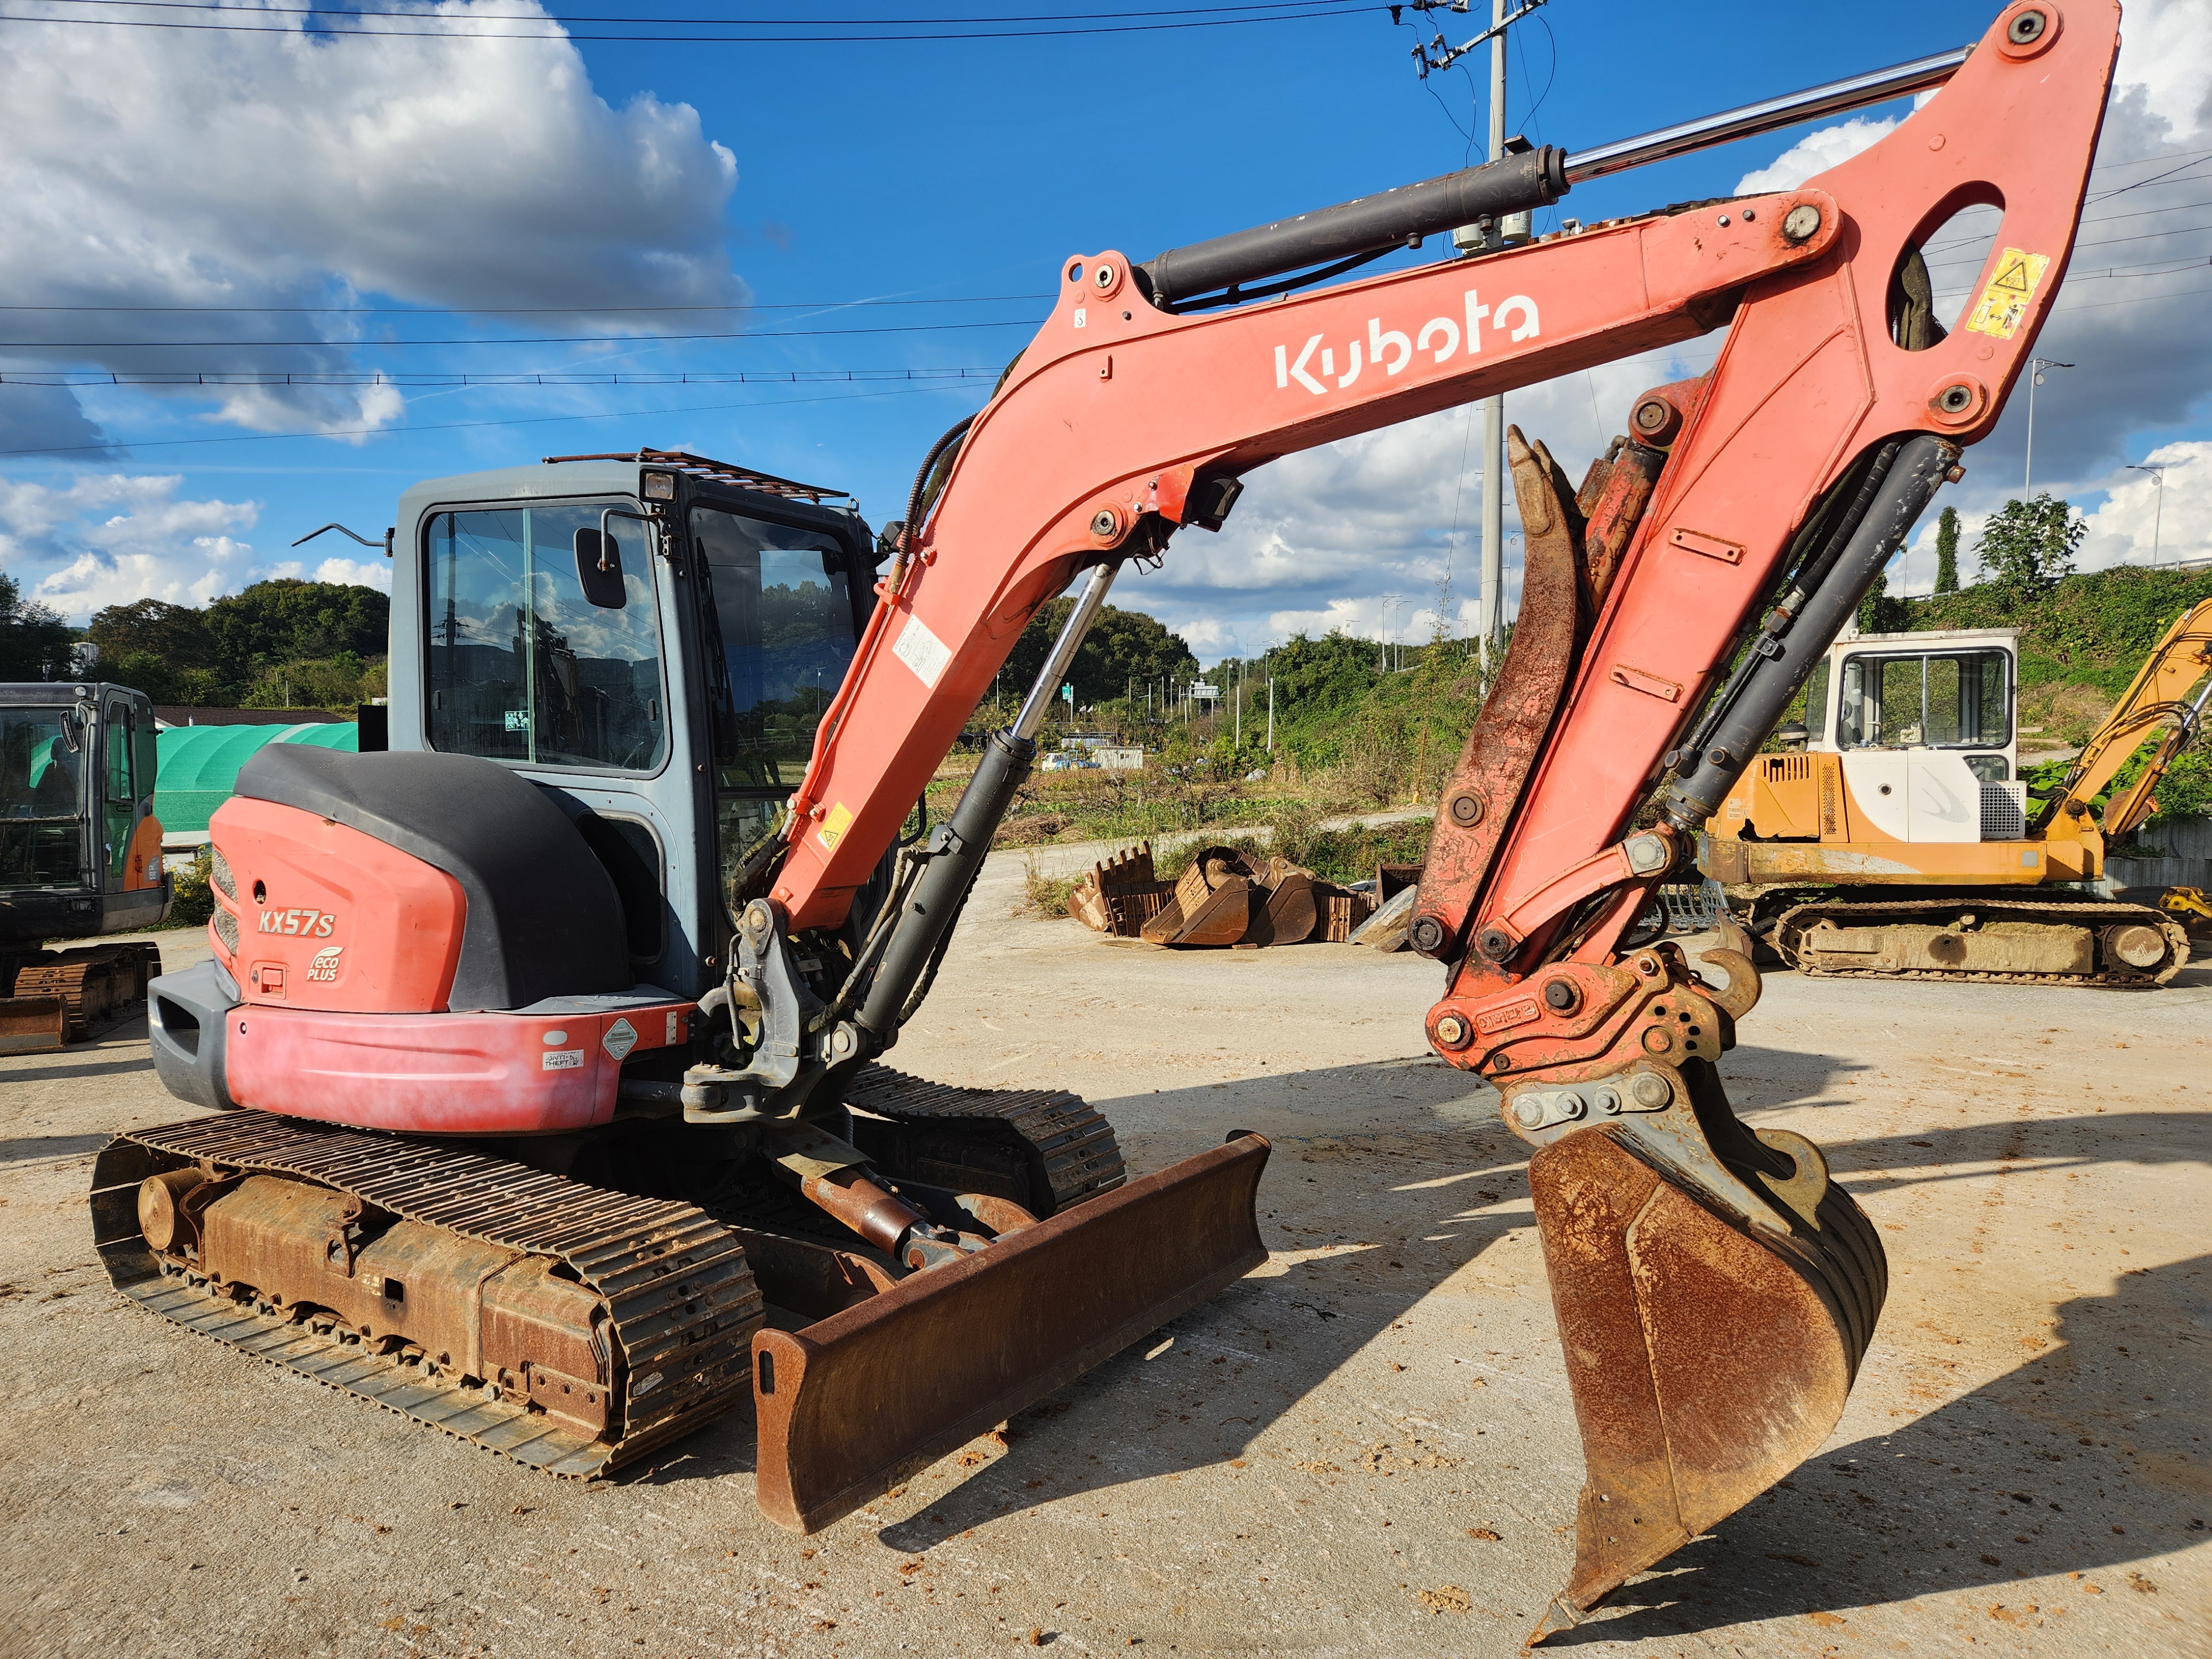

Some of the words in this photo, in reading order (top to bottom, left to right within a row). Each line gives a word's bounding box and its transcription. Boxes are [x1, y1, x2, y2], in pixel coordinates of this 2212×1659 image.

[1274, 289, 1540, 395] Kubota
[258, 909, 336, 938] KX57S
[306, 969, 338, 982] PLUS
[314, 957, 340, 969] eco
[1478, 1003, 1537, 1029] 에버다임
